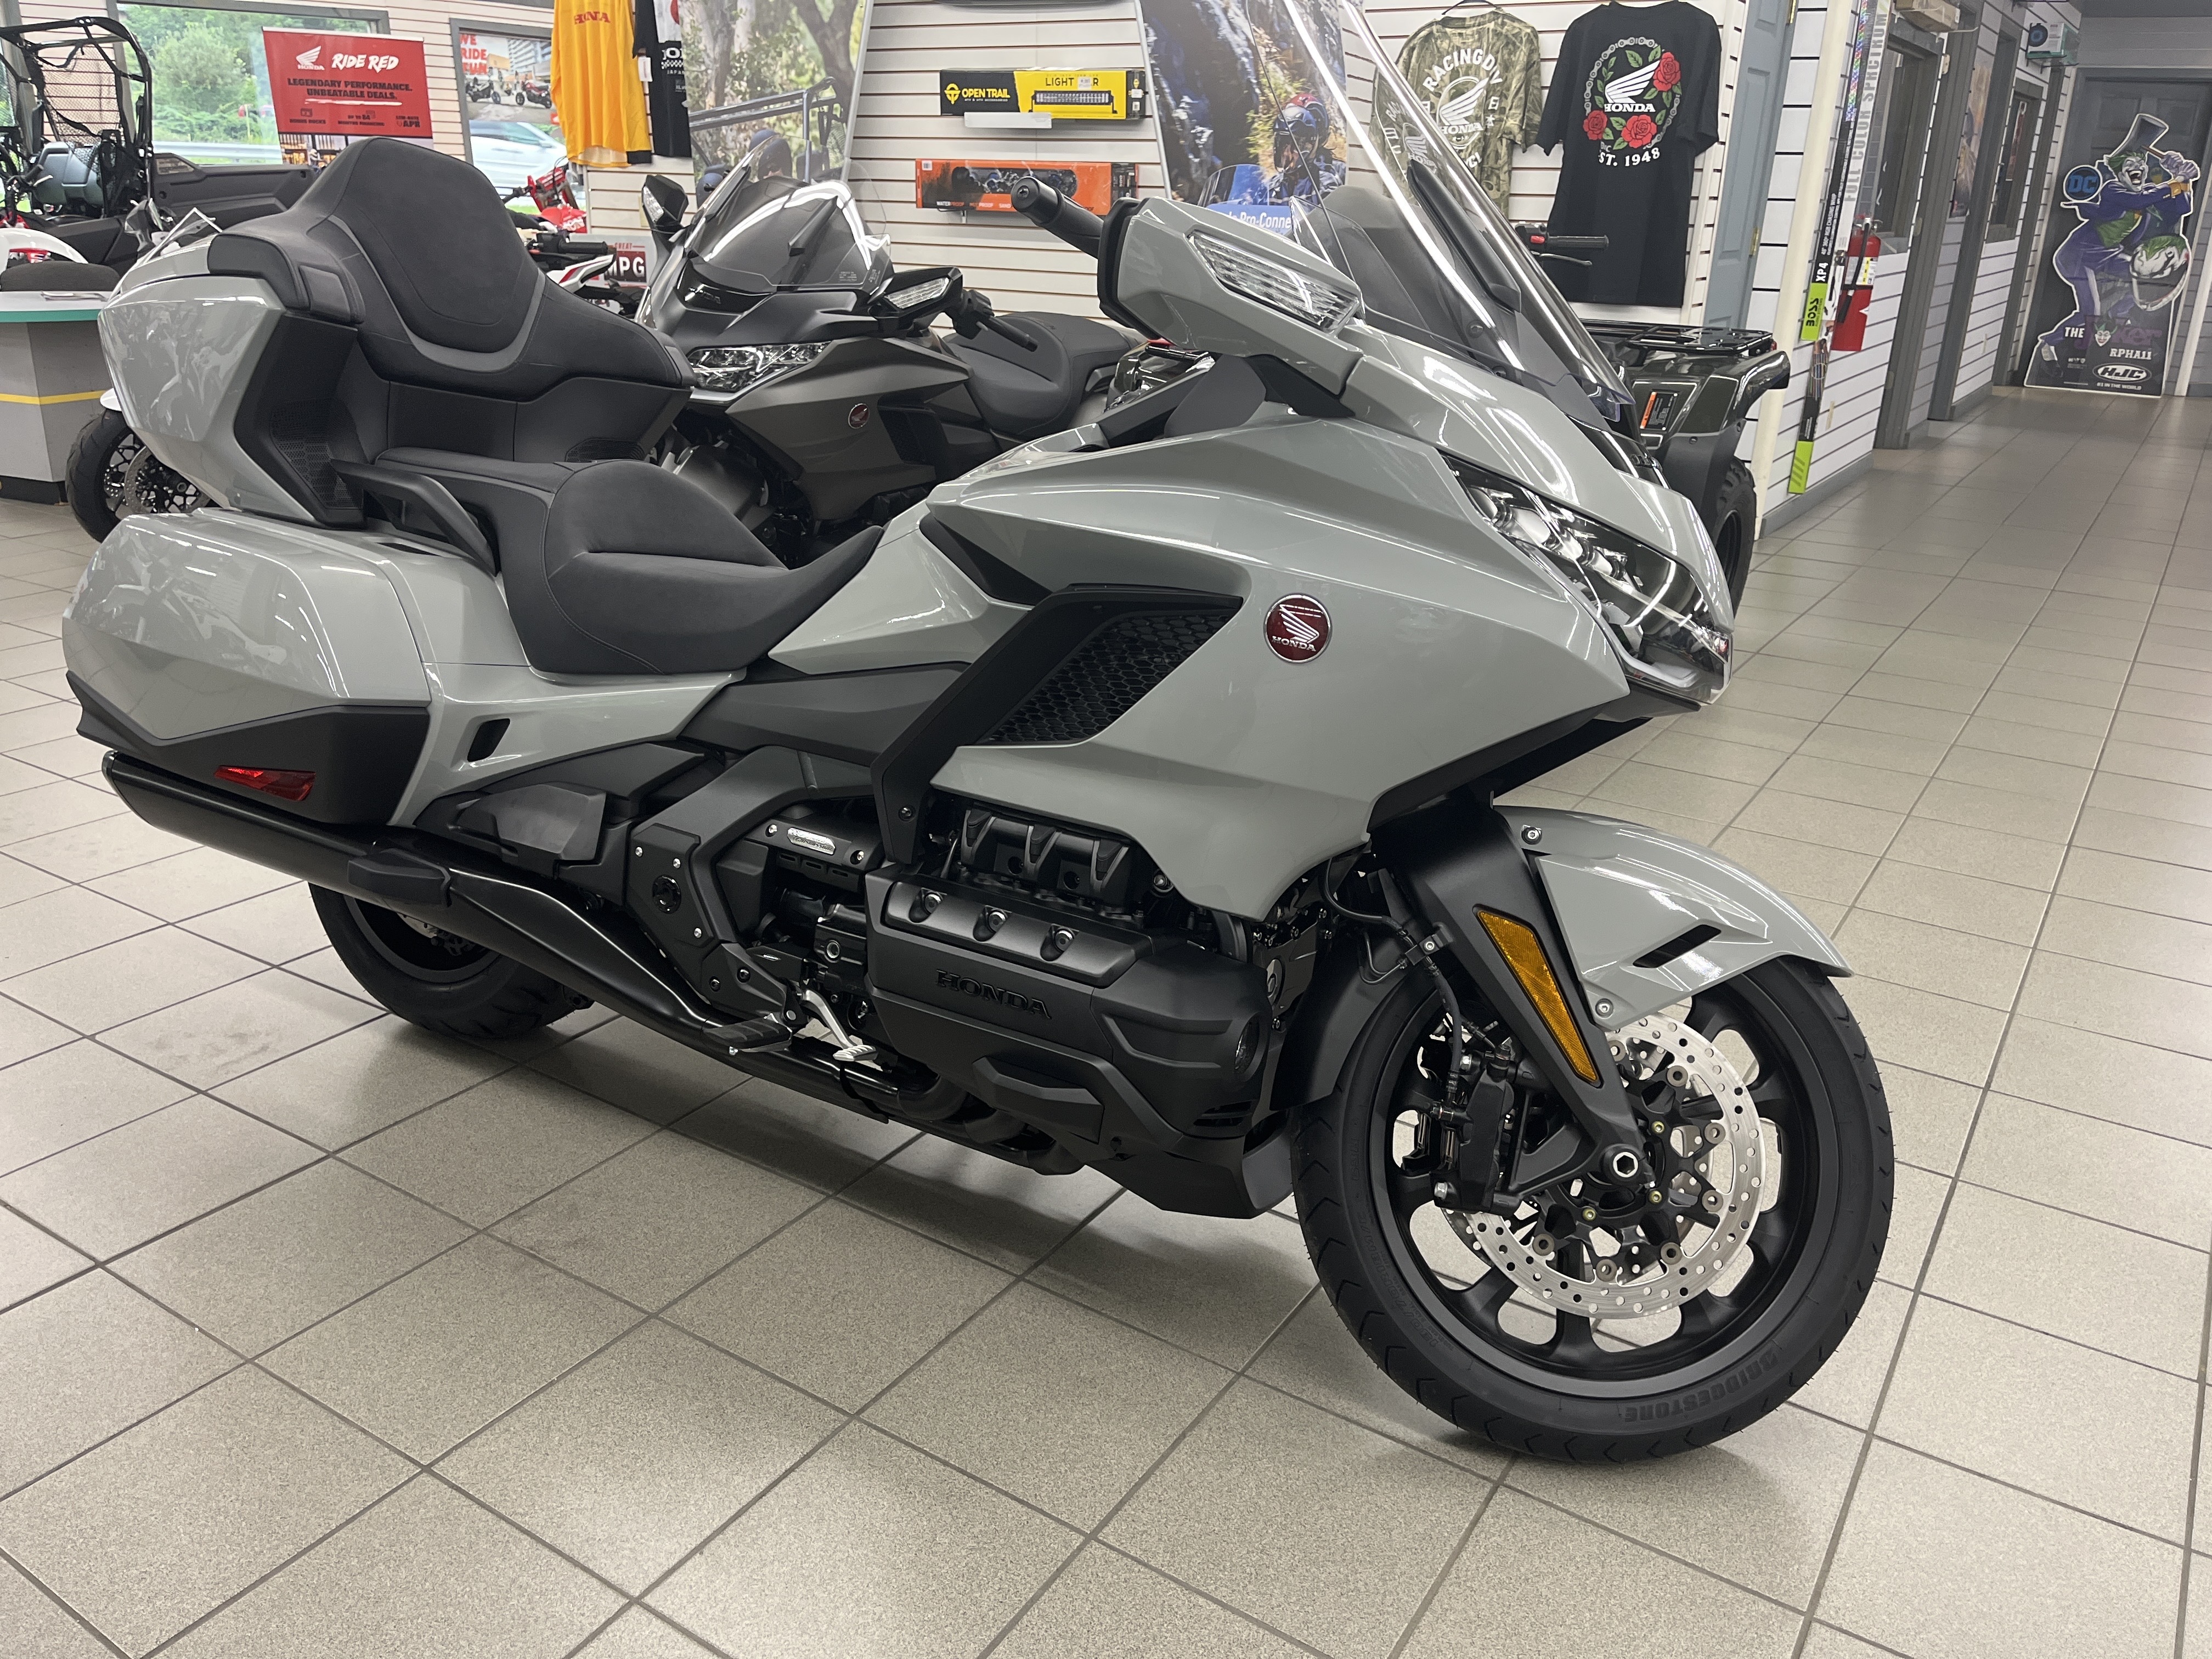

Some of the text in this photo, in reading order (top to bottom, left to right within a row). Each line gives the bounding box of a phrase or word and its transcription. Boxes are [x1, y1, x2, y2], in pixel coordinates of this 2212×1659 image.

[460, 34, 477, 46] WE
[461, 48, 487, 60] RIDE
[331, 53, 399, 73] RIDE RED
[287, 78, 413, 91] LEGENDARY PERFORMANCE.
[1045, 77, 1075, 87] LIGHT
[307, 88, 397, 99] UNBEATABLE DEALS.
[961, 88, 1011, 98] OPEN TRAIL
[1604, 103, 1656, 112] HONDA
[1598, 147, 1660, 167] ST. 1948
[2068, 174, 2098, 194] DC
[1815, 262, 1829, 282] XP4
[2064, 326, 2085, 338] THE
[2100, 366, 2144, 379] HJC
[1272, 635, 1317, 652] HONDA
[935, 968, 1052, 1020] HONDA
[1624, 1347, 1779, 1423] BRIDGESTONE
